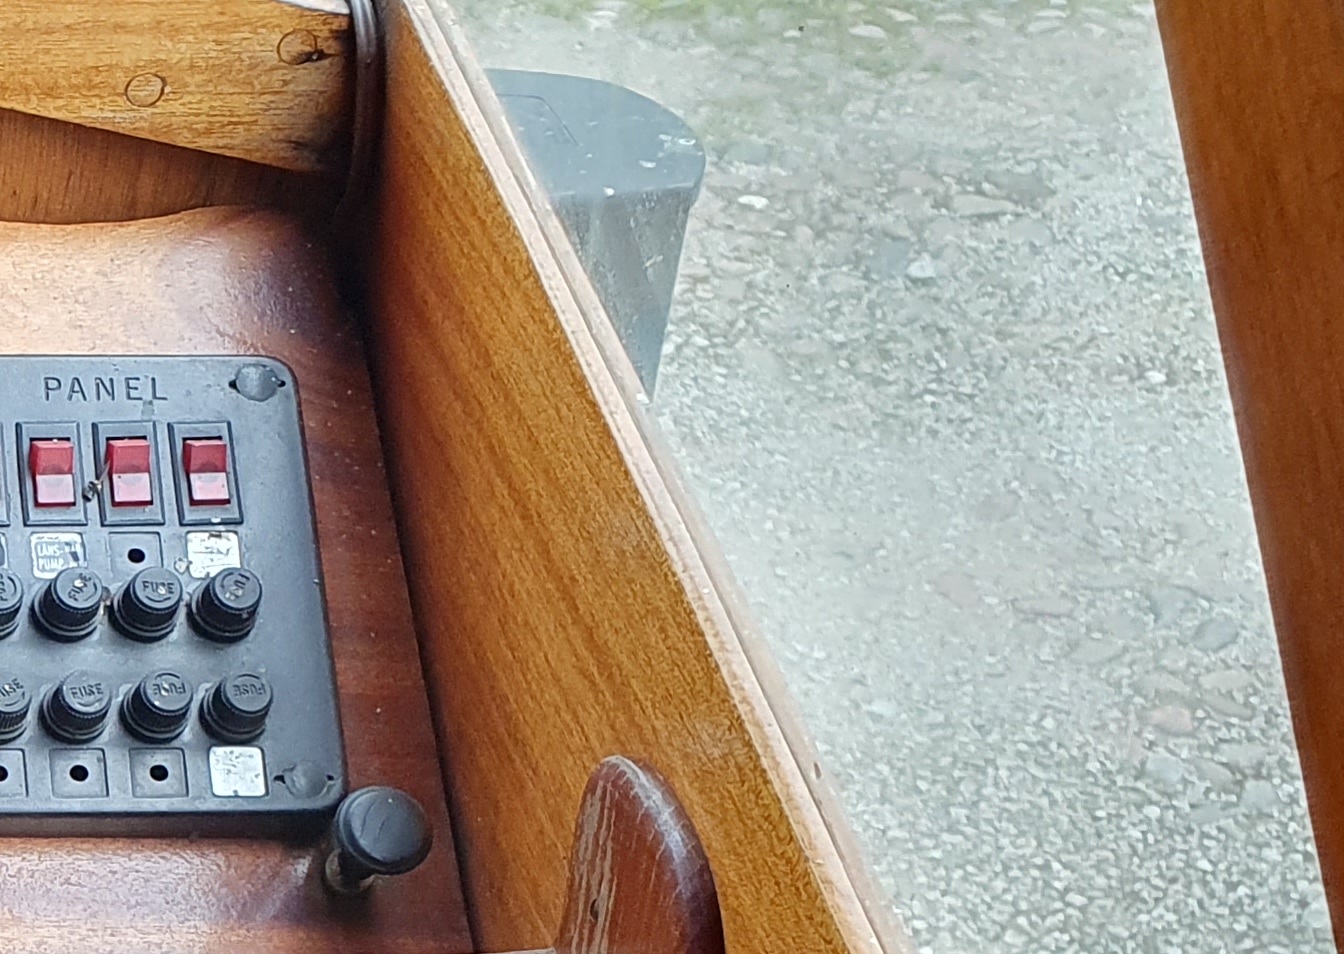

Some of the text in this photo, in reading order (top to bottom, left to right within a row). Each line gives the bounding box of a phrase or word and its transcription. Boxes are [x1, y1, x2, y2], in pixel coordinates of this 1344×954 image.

[43, 375, 169, 402] PANEL
[69, 683, 104, 698] FUSE
[232, 683, 266, 697] FUSE
